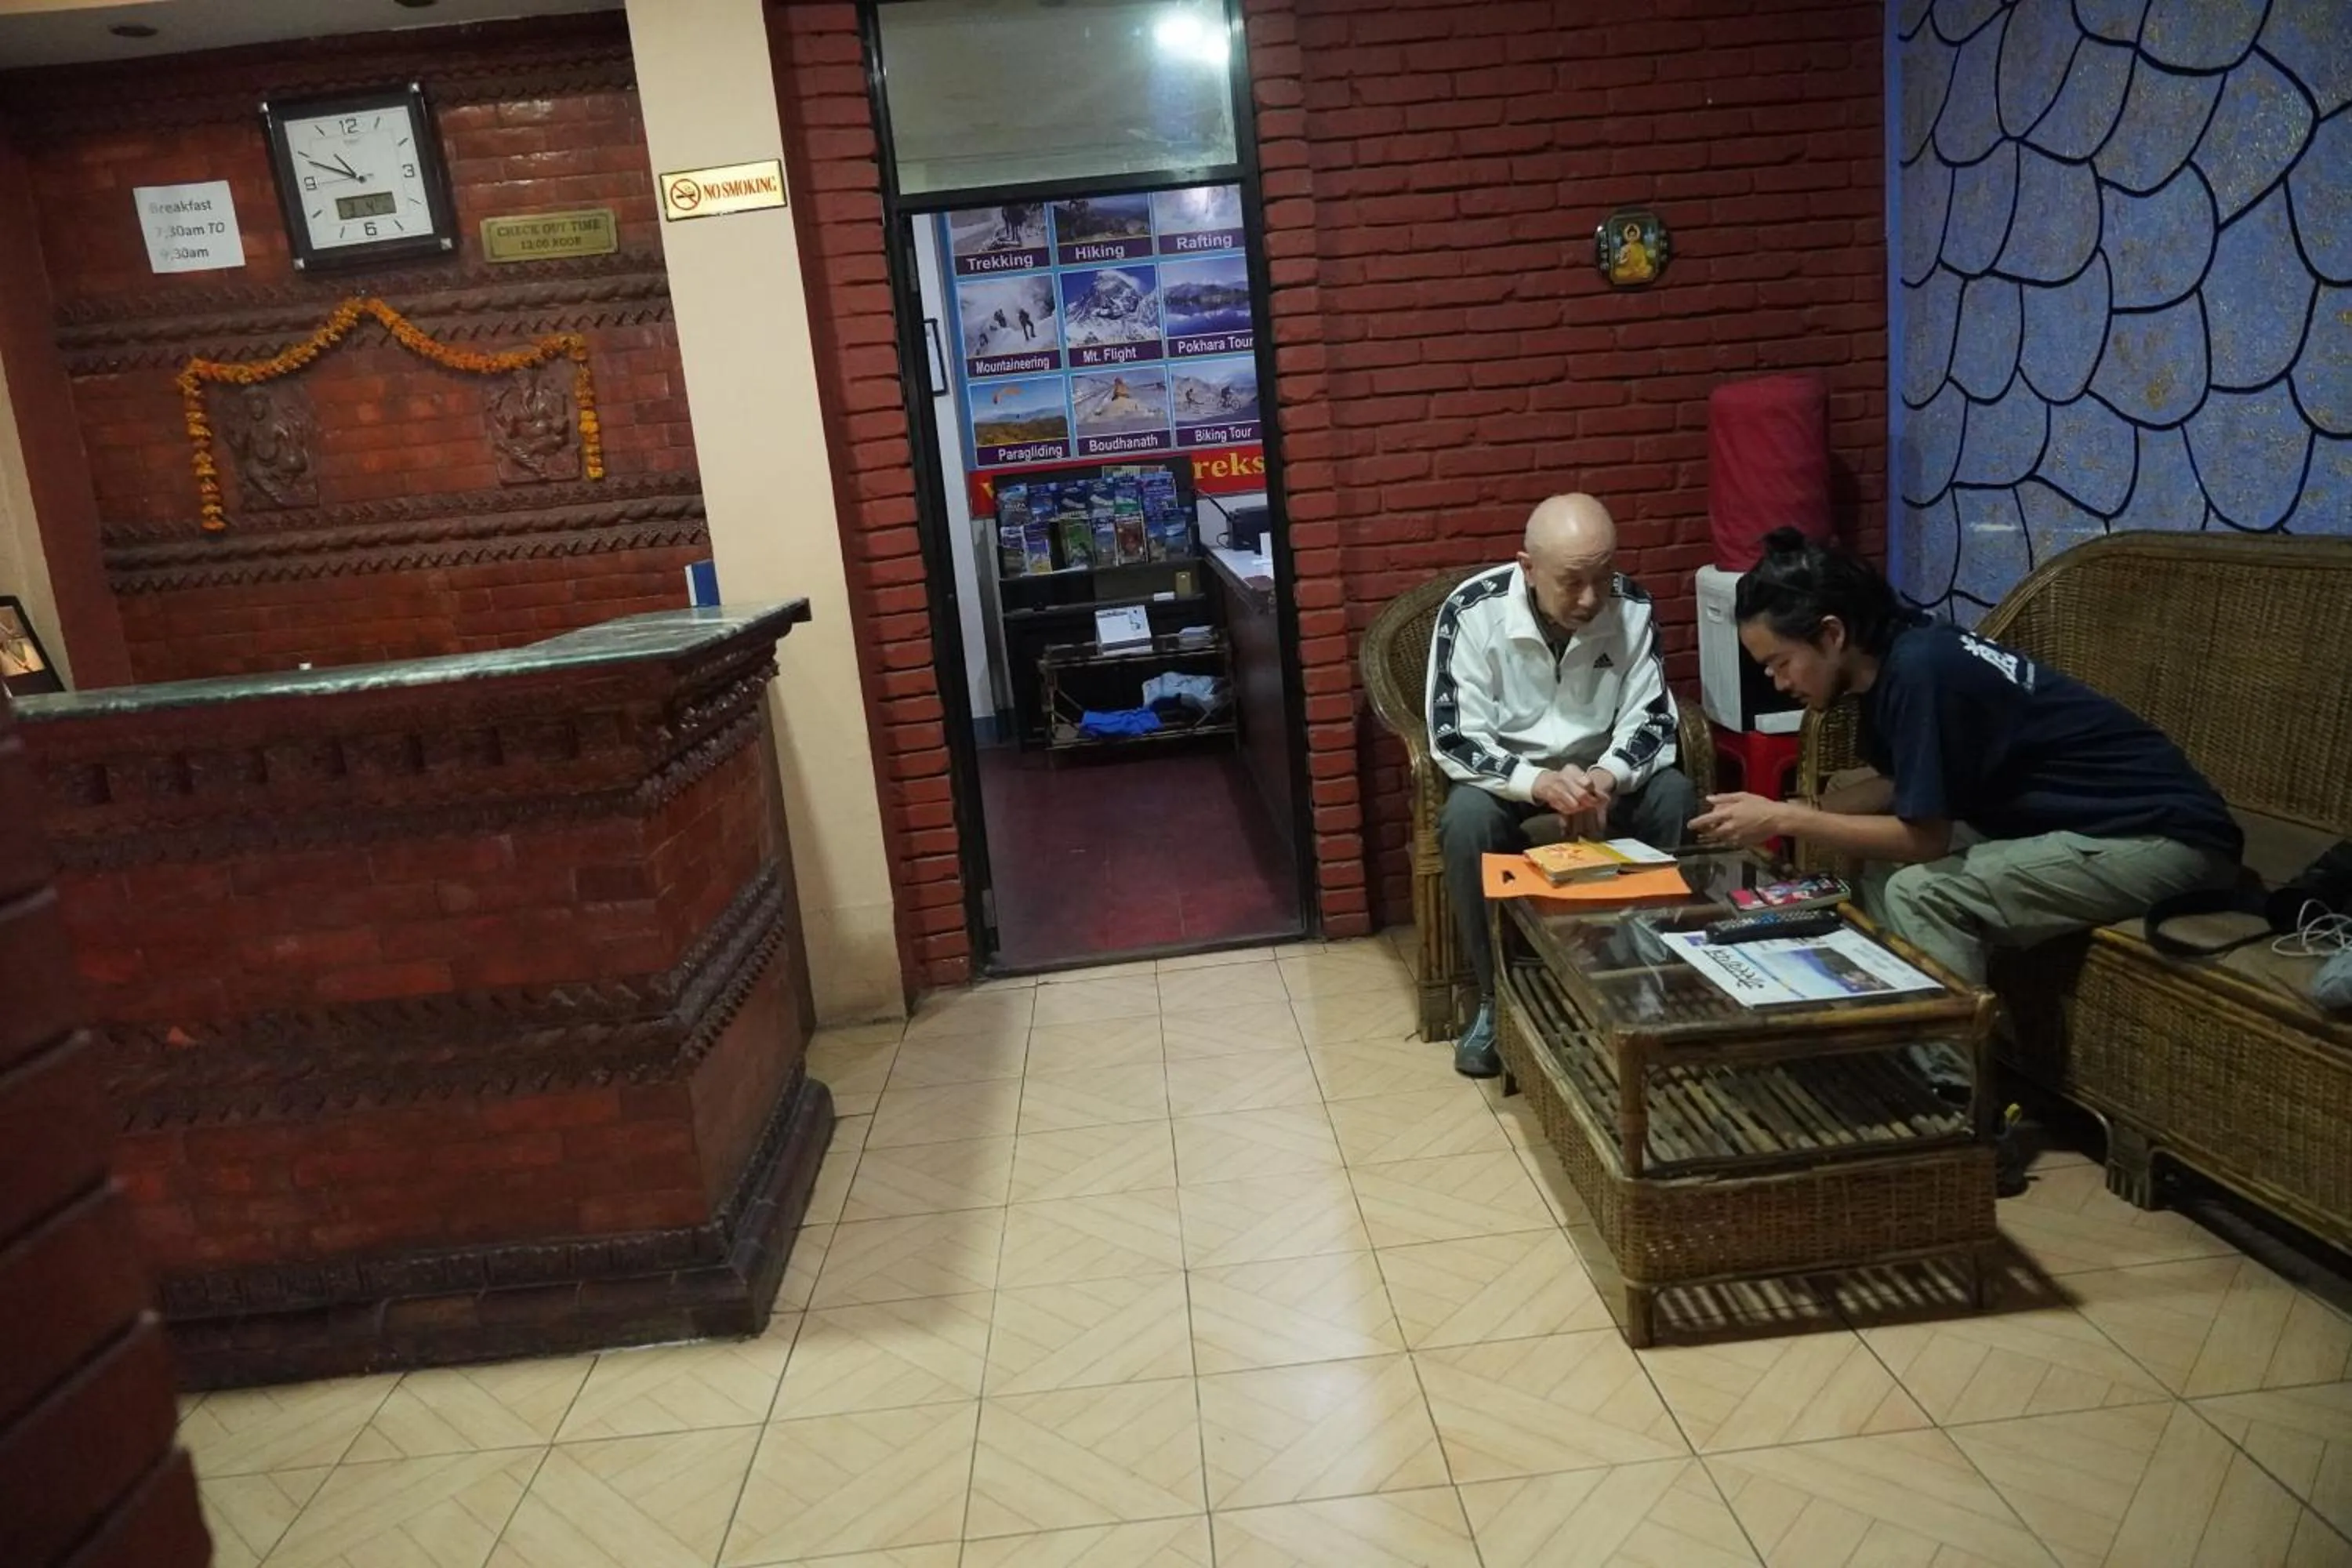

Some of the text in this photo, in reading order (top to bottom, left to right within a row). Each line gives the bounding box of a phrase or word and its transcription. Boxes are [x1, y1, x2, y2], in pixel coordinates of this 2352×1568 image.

[339, 118, 358, 135] 12
[402, 163, 415, 178] 3
[303, 176, 318, 191] 9
[703, 175, 777, 200] NO SMOKING
[149, 200, 212, 214] Breakfast
[208, 222, 225, 234] TO
[364, 222, 377, 236] 6
[496, 217, 601, 237] CHECK OUT TIME
[1176, 234, 1232, 250] Rafting
[1075, 245, 1124, 260] Hiking
[966, 254, 1033, 270] Trekking
[1178, 336, 1253, 354] Pokhara Tour
[1083, 346, 1137, 363] Mt. Flight
[975, 356, 1050, 374] Mountaineering
[1089, 434, 1158, 452] Boudhanath
[1195, 426, 1253, 443] Biking Tour
[998, 444, 1062, 462] Paragliding
[1192, 452, 1265, 480] reks
